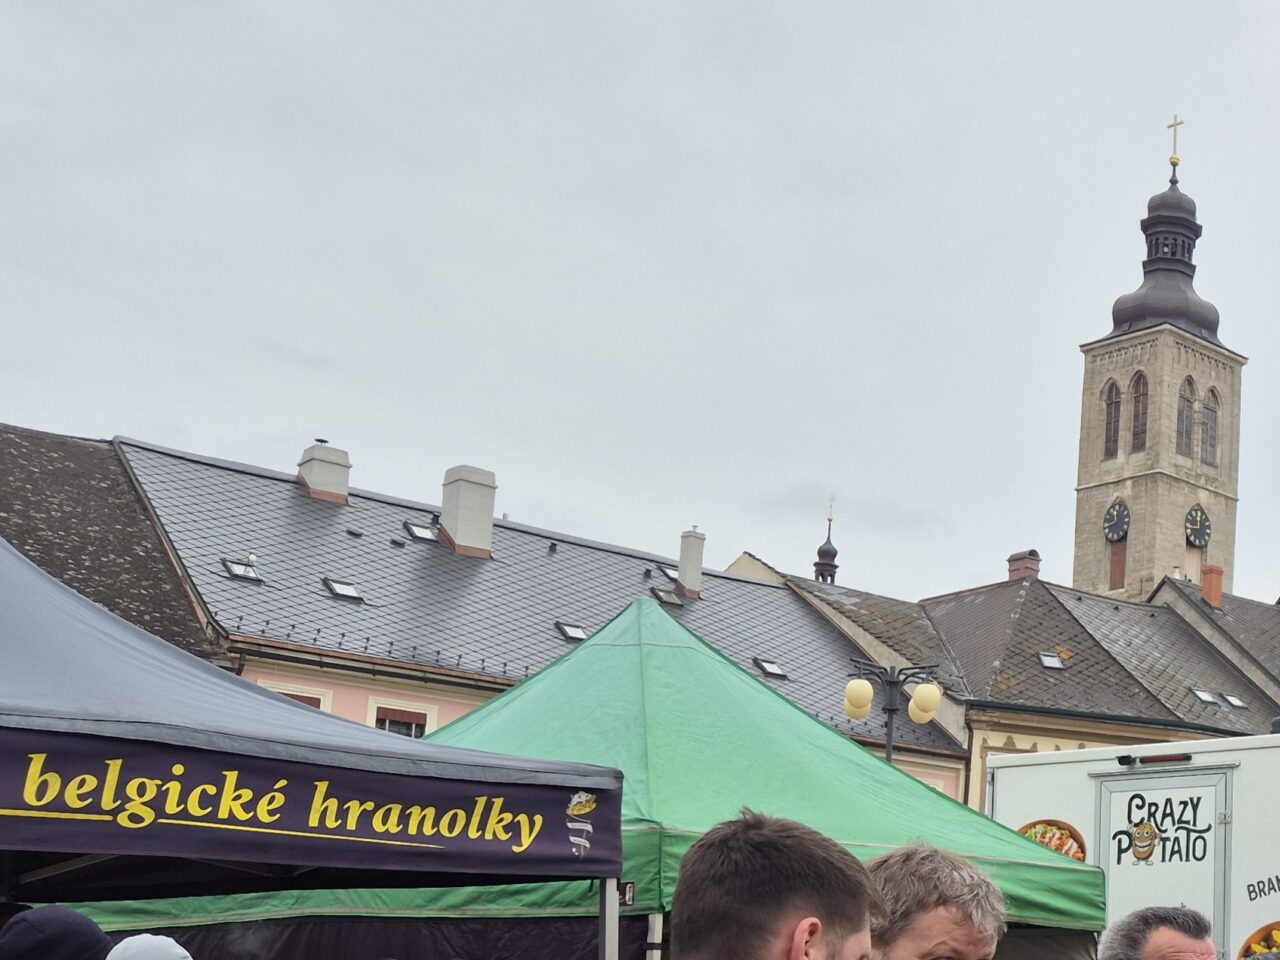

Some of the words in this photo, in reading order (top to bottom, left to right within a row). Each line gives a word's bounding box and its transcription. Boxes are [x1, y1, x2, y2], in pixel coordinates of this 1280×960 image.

[22, 752, 289, 829] belgické
[307, 780, 544, 853] hranolky
[1127, 793, 1202, 833] CRAZY
